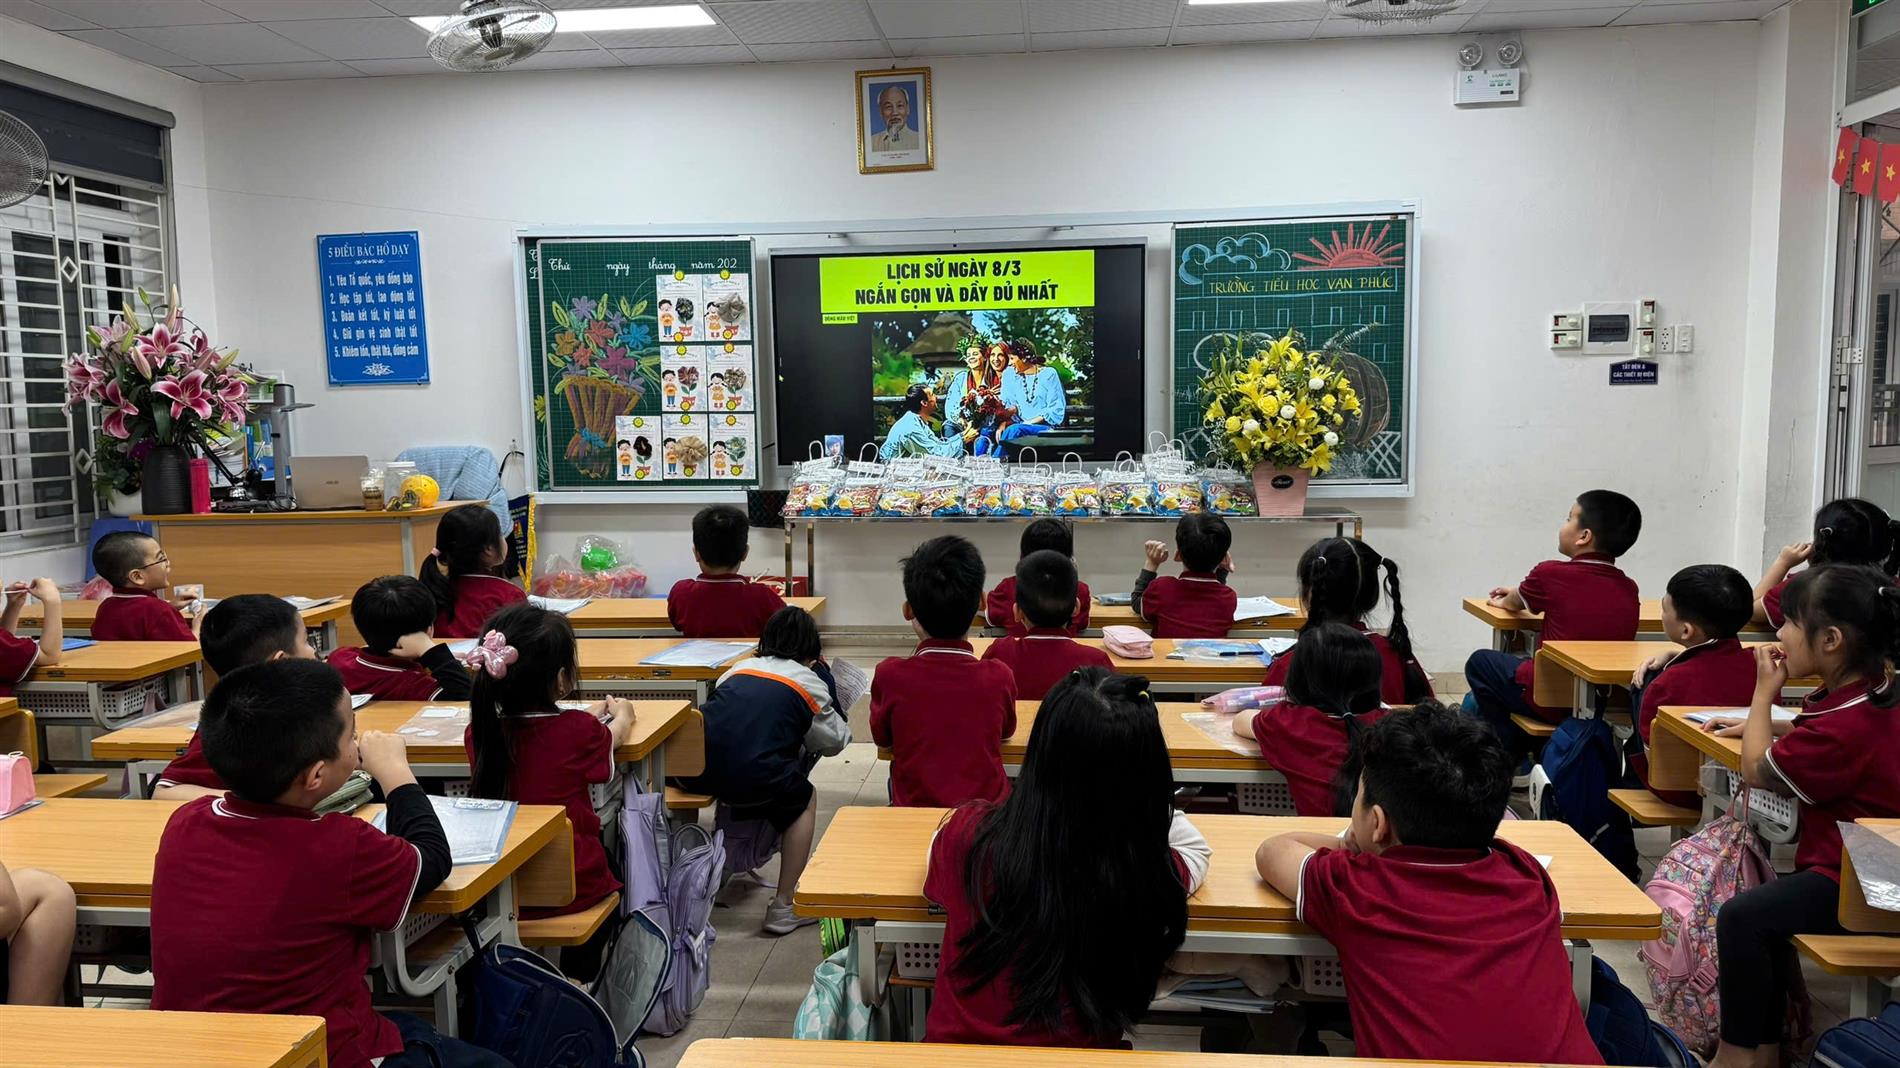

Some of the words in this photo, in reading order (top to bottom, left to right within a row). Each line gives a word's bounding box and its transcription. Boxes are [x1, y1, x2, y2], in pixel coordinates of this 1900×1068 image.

[328, 248, 333, 258] 5
[334, 242, 355, 258] ĐIỀU
[357, 243, 375, 256] BÁC
[377, 240, 390, 256] HỒ
[391, 244, 409, 257] DẠY
[717, 257, 737, 268] 202
[887, 264, 920, 284] LỊCH
[925, 258, 945, 278] SỬ
[948, 258, 988, 278] NGÀY
[992, 260, 1021, 276] 8/3
[329, 275, 334, 286] 1.
[1209, 276, 1256, 294] TRƯỜNG
[1264, 274, 1288, 292] TIỂU
[1327, 277, 1352, 292] VẠN
[1358, 270, 1394, 288] PHÚC
[330, 293, 336, 304] 2.
[855, 282, 897, 304] NGẮN
[901, 288, 931, 309] GỌN
[936, 283, 954, 302] VÀ
[960, 280, 988, 302] ĐẦY
[993, 280, 1013, 301] ĐỦ
[1018, 279, 1058, 300] NHẤT
[334, 346, 340, 357] 5.
